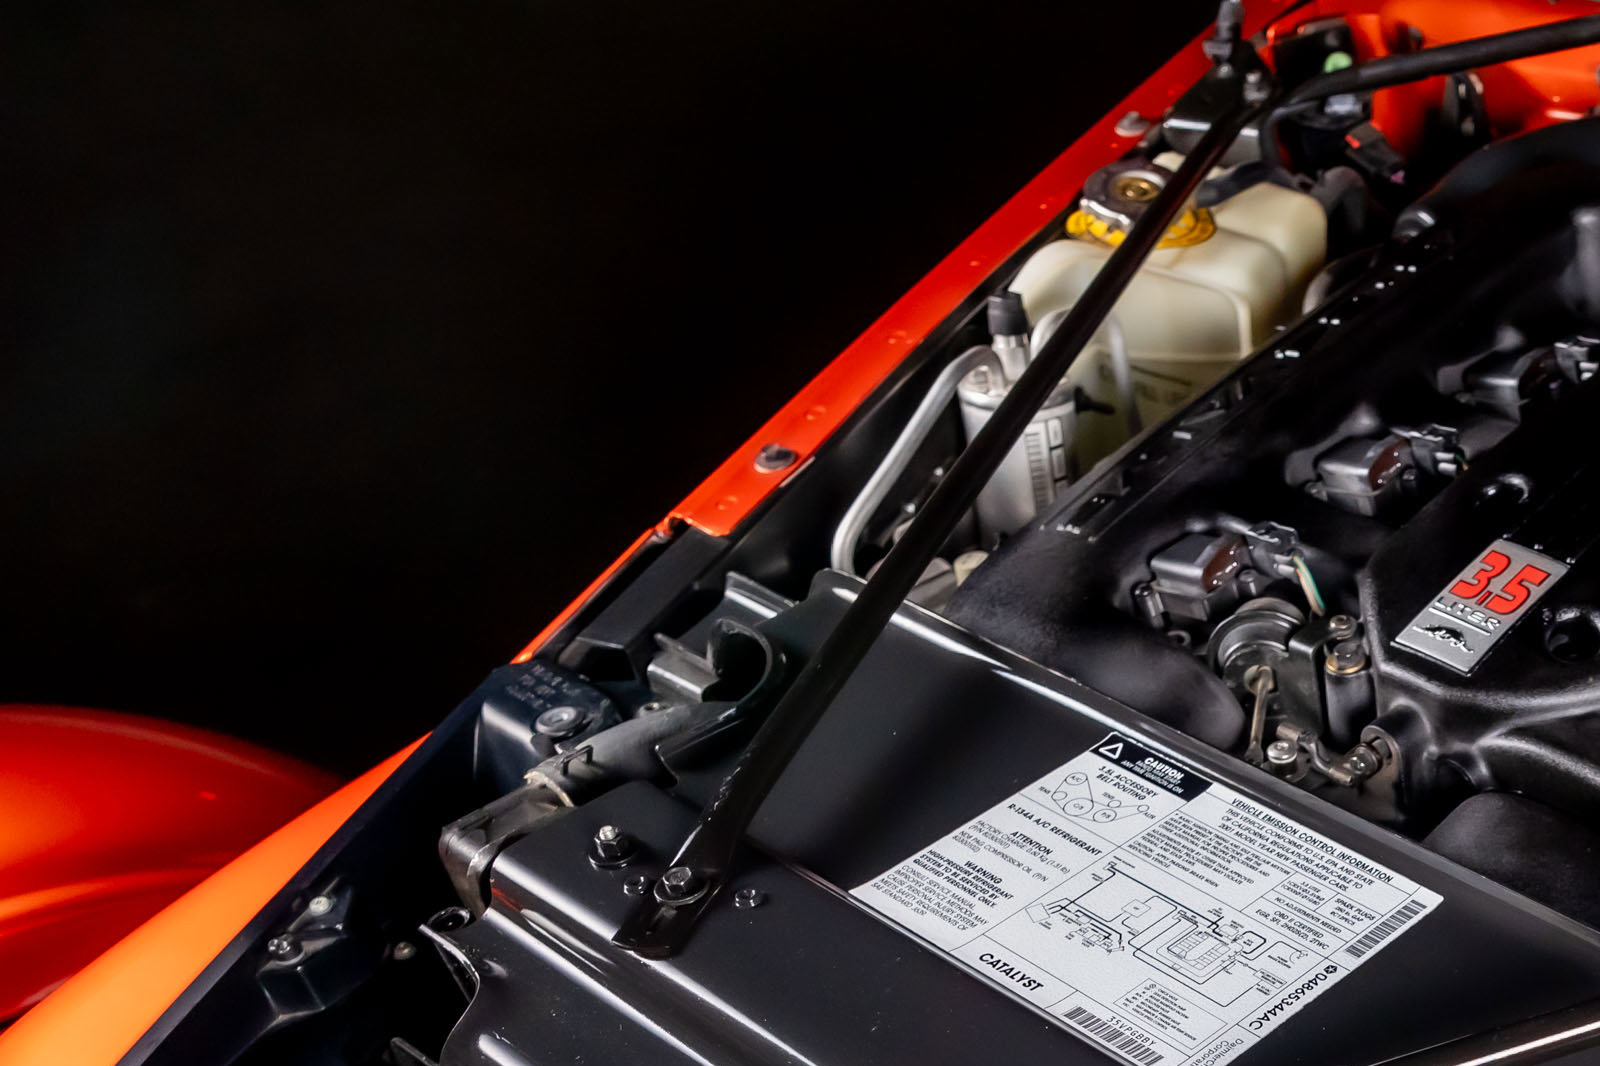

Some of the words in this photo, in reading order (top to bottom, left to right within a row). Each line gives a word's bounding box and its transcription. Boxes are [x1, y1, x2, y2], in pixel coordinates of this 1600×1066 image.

[1449, 550, 1551, 616] 3.5
[1433, 596, 1501, 630] LITER
[1096, 773, 1114, 783] BELT
[1112, 781, 1146, 800] ROUTING
[1114, 774, 1158, 797] ACCESSORY
[1144, 757, 1184, 780] CAUTION
[1007, 803, 1034, 820] R-134A
[1032, 817, 1051, 828] A/C
[1049, 826, 1102, 855] REFRIGERANT
[1010, 831, 1053, 855] ATTENTION
[1226, 808, 1241, 817] THIS
[1239, 815, 1266, 831] VEHICLE
[1265, 828, 1304, 850] CONFORMS
[1302, 847, 1314, 855] TO
[1324, 858, 1338, 868] EPA
[1337, 865, 1355, 876] AND
[1354, 873, 1375, 885] STATE
[1231, 798, 1263, 817] VEHICLE
[1261, 814, 1299, 835] EMISSION
[1298, 832, 1337, 855] CONTROL
[1336, 851, 1393, 882] INFORMATION
[919, 854, 944, 868] SYSTEM
[959, 876, 990, 894] SERVICED
[927, 849, 973, 877] HIGH-PRESSURE
[972, 875, 1013, 899] REFRIGERANT
[964, 860, 1002, 884] WARNING
[1231, 821, 1270, 842] CALIFORNIA
[1270, 840, 1314, 864] REGULATIONS
[1313, 862, 1353, 884] APPLICABLE
[1352, 881, 1363, 889] TO
[1234, 830, 1257, 845] MODEL
[1257, 842, 1276, 854] YEAR
[1274, 851, 1291, 861] NEW
[1290, 859, 1329, 881] PASSENGER
[913, 858, 944, 877] QUALIFIED
[943, 875, 978, 898] PERSONNEL
[979, 953, 1043, 991] CATALYST
[1249, 972, 1328, 1031] 04865344AC
